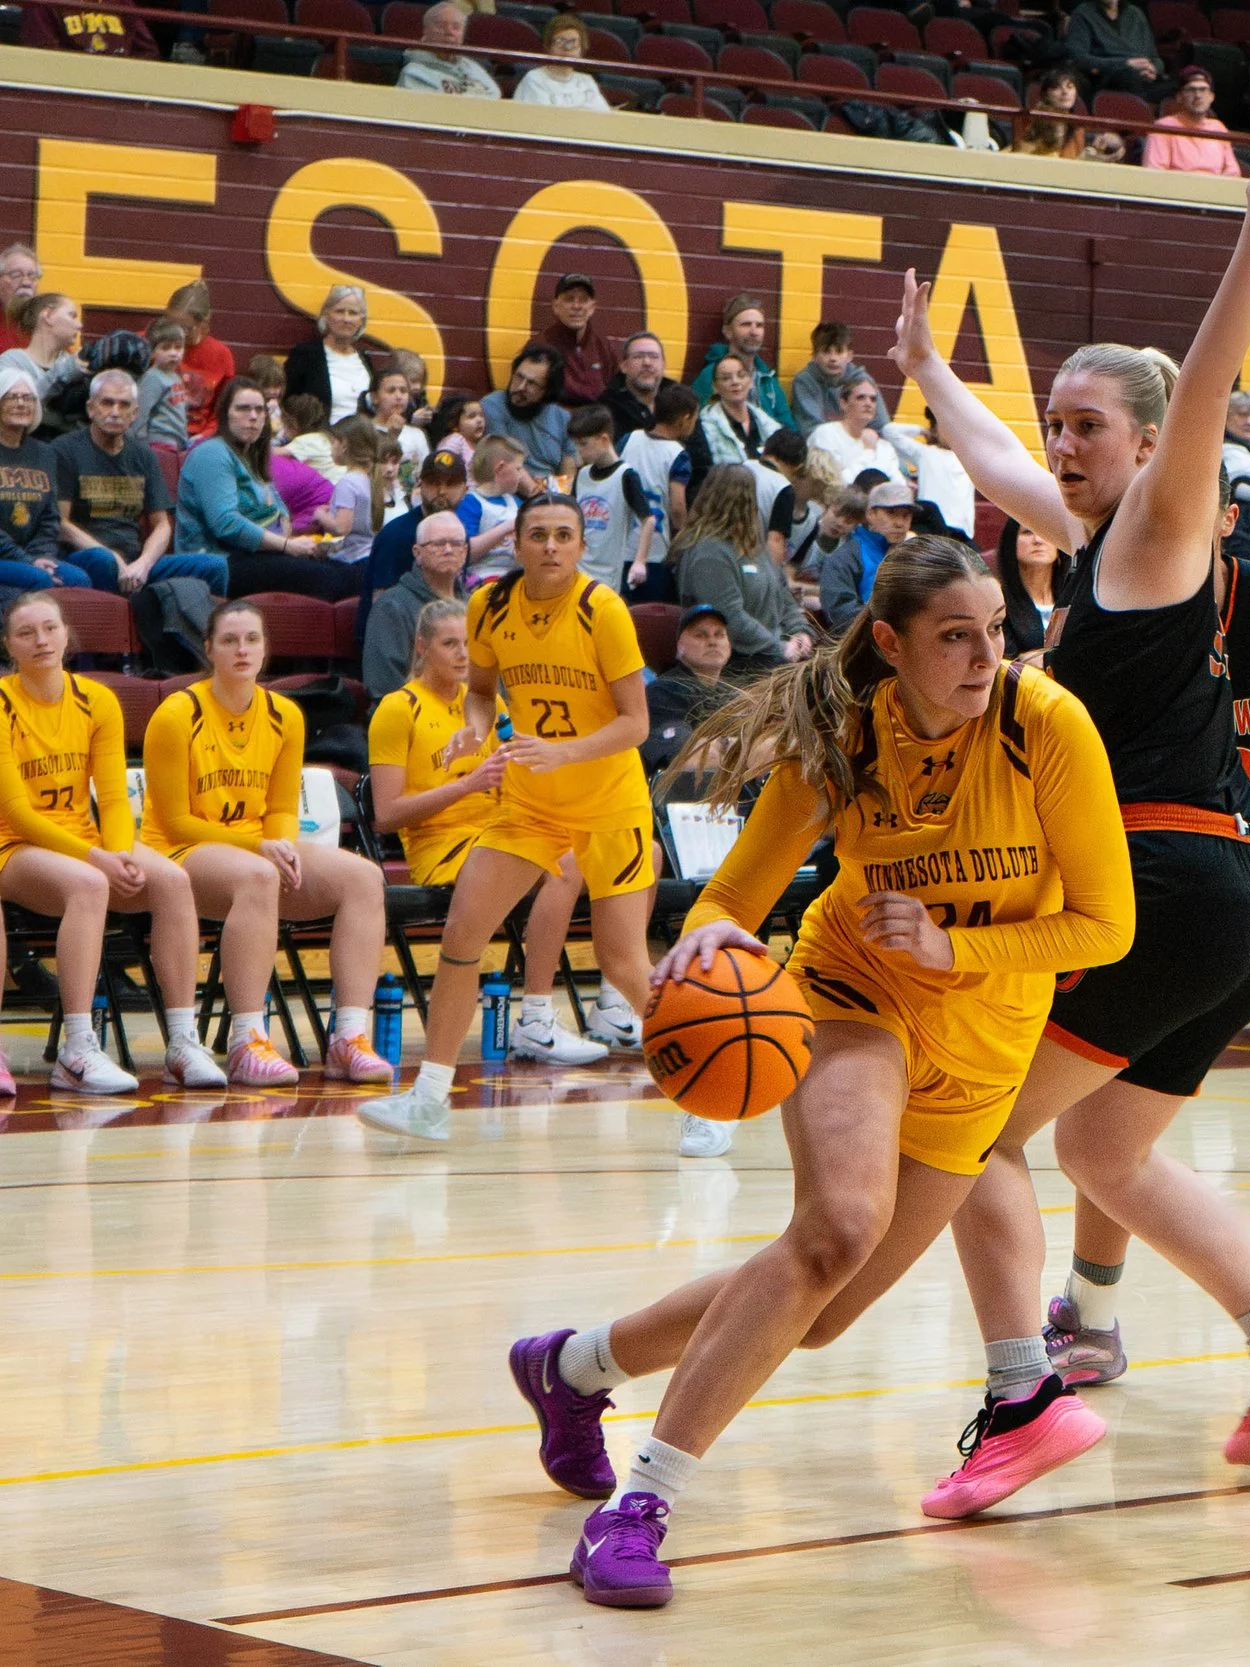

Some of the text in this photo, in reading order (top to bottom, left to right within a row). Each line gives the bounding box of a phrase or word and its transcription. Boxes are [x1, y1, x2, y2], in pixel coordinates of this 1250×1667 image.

[552, 665, 597, 691] DULUTH
[531, 698, 577, 738] 23
[863, 845, 1039, 894] MINNESOTA DULUTH
